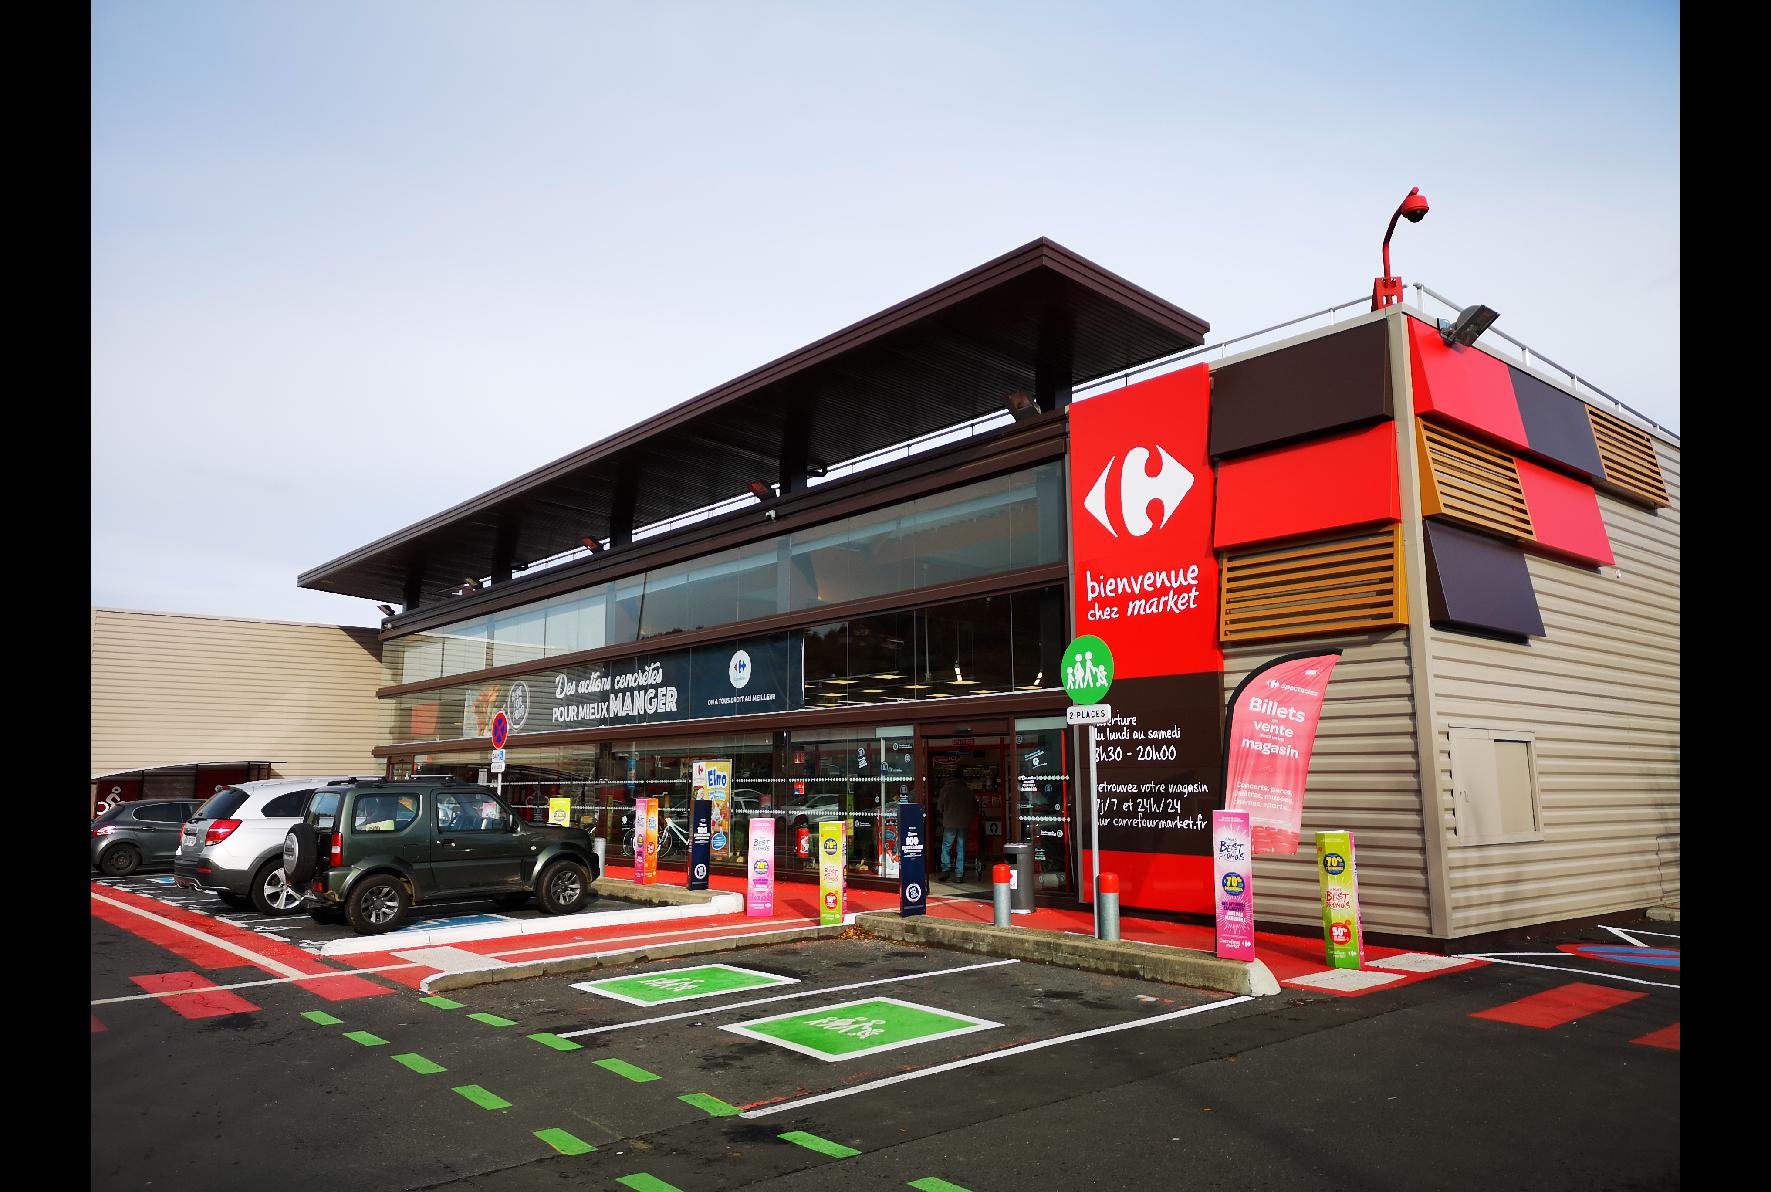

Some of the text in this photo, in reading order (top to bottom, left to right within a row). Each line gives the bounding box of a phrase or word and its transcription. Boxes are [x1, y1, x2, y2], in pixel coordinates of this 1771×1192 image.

[1086, 564, 1199, 601] bienvenue
[1087, 587, 1199, 620] chez market
[555, 661, 663, 698] Des actions concrètes
[553, 686, 677, 722] POUR MIEUX MANGER
[1249, 697, 1306, 723] Billets
[1069, 710, 1106, 719] 2 PLACES
[1106, 727, 1130, 740] lundi
[1133, 730, 1146, 739] au
[1148, 725, 1181, 739] samedi
[1253, 720, 1294, 738] vente
[1136, 745, 1177, 761] 20h00
[1241, 737, 1299, 759] magasin
[1096, 781, 1209, 797] etrouvez votre magasin
[1122, 800, 1133, 812] et
[1137, 798, 1181, 813] 24h/24
[1112, 813, 1208, 830] carrefourmarket.fr
